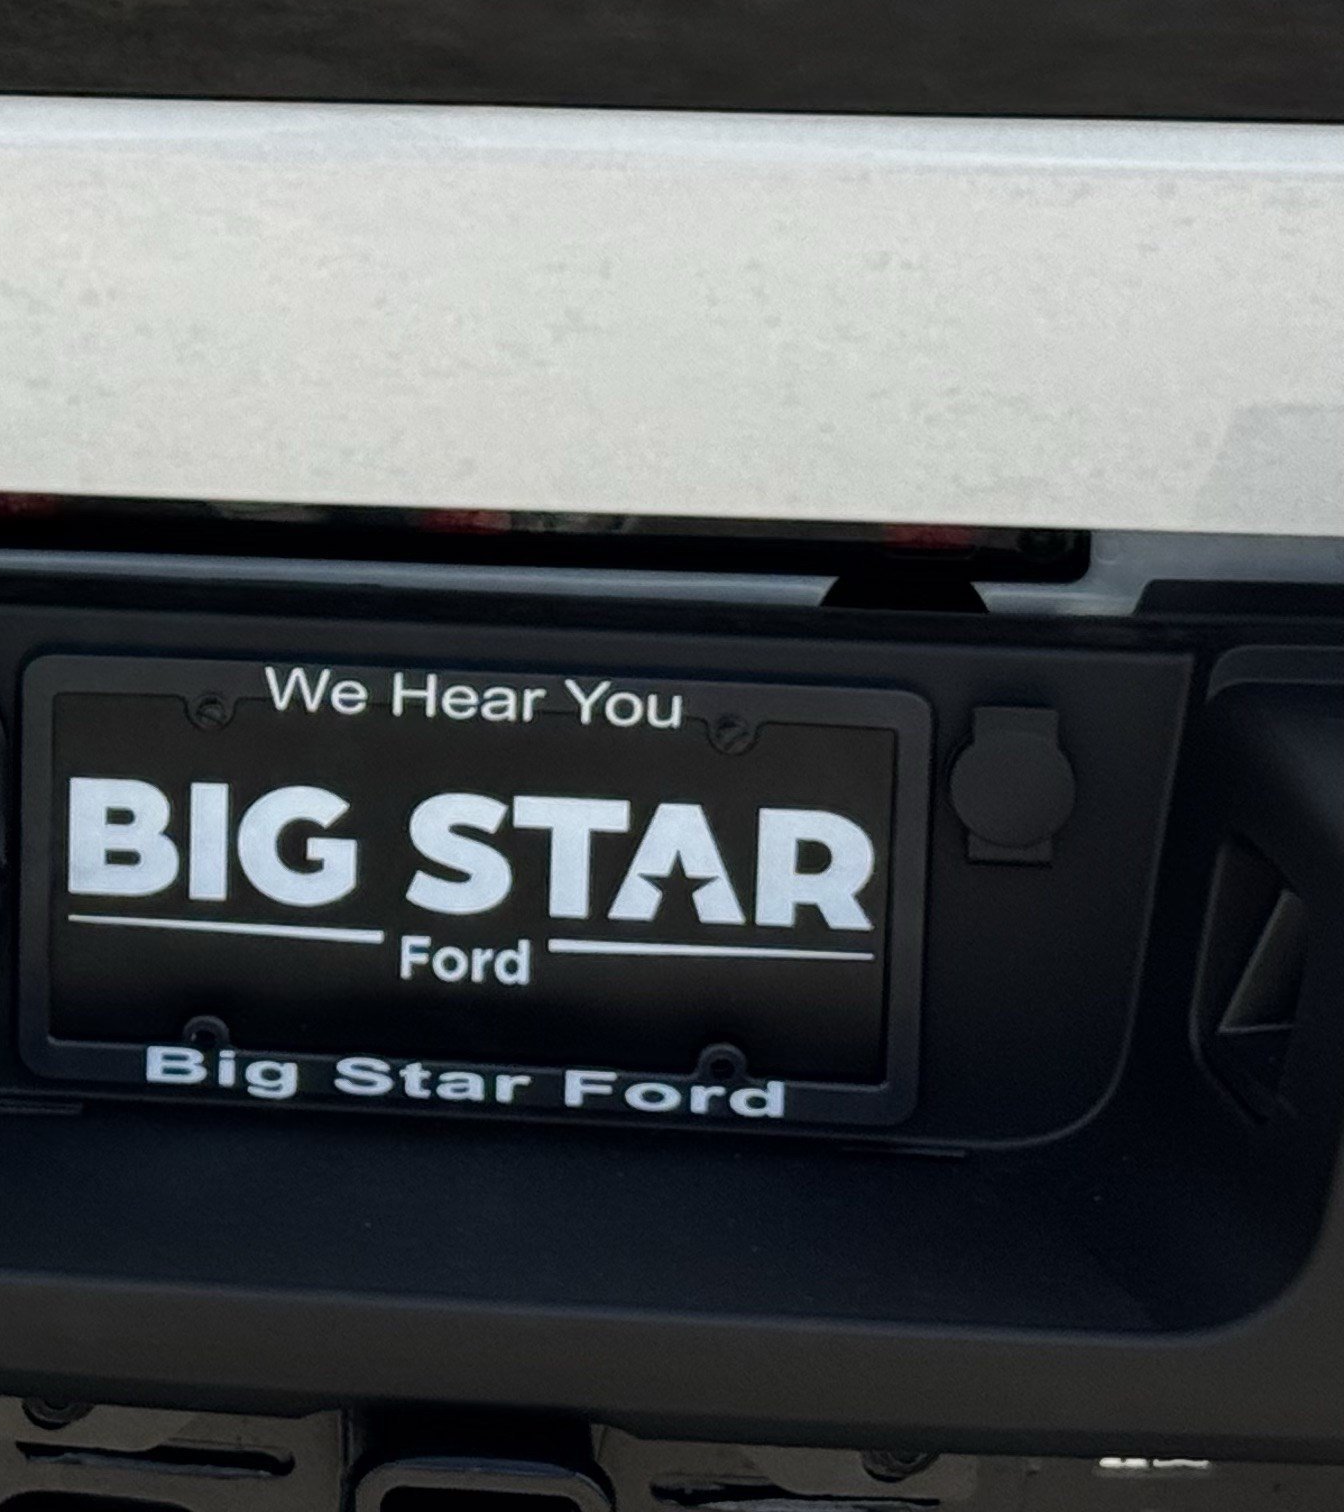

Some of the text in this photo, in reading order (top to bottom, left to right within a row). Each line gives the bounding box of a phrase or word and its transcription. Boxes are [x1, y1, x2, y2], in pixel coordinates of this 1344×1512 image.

[264, 666, 683, 729] We Hear You
[67, 776, 876, 931] BIG STAR
[400, 934, 531, 986] Ford
[145, 1045, 785, 1118] Big Star Ford
